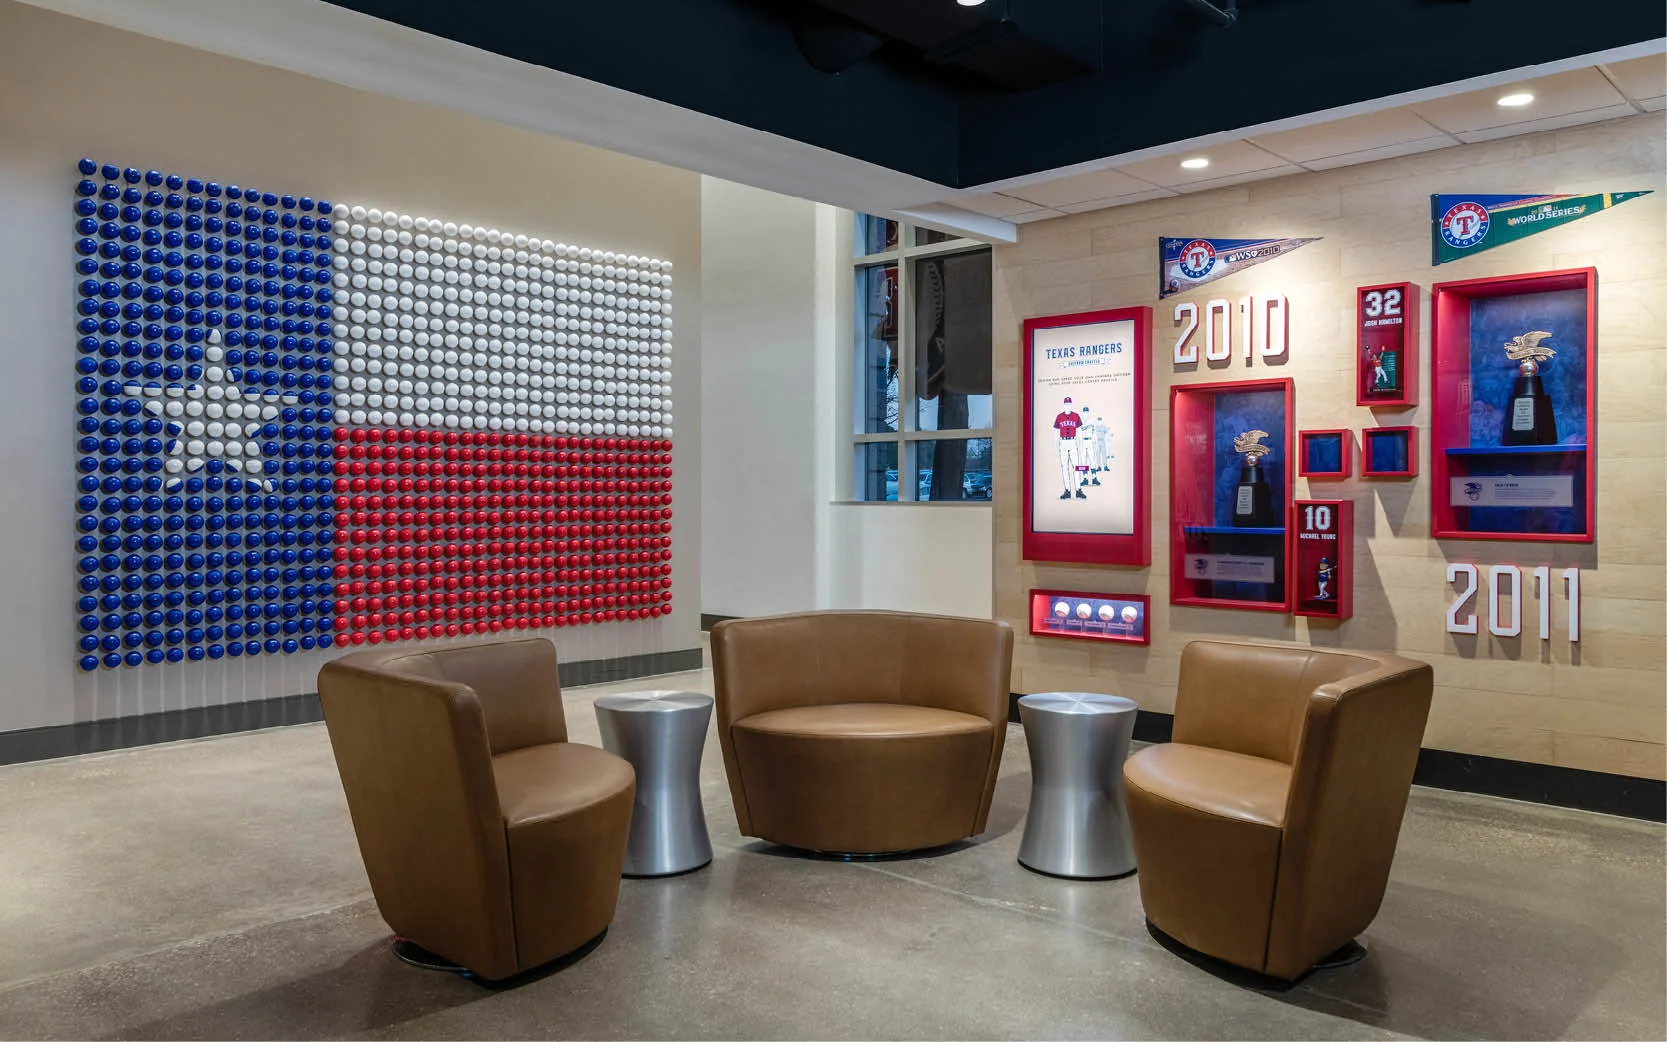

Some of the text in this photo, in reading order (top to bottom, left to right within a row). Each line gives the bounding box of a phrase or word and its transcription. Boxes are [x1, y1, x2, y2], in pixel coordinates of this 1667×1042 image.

[1448, 205, 1482, 218] TEXAS
[1513, 206, 1580, 224] WORLD SERIES
[1444, 225, 1487, 245] RANGERS
[1456, 215, 1474, 235] T
[1190, 251, 1205, 268] T
[1365, 289, 1401, 317] 32
[1174, 294, 1286, 364] 2010
[1046, 343, 1122, 359] TEXAS RANGERS
[1304, 505, 1331, 530] 10
[1447, 562, 1580, 642] 2011
